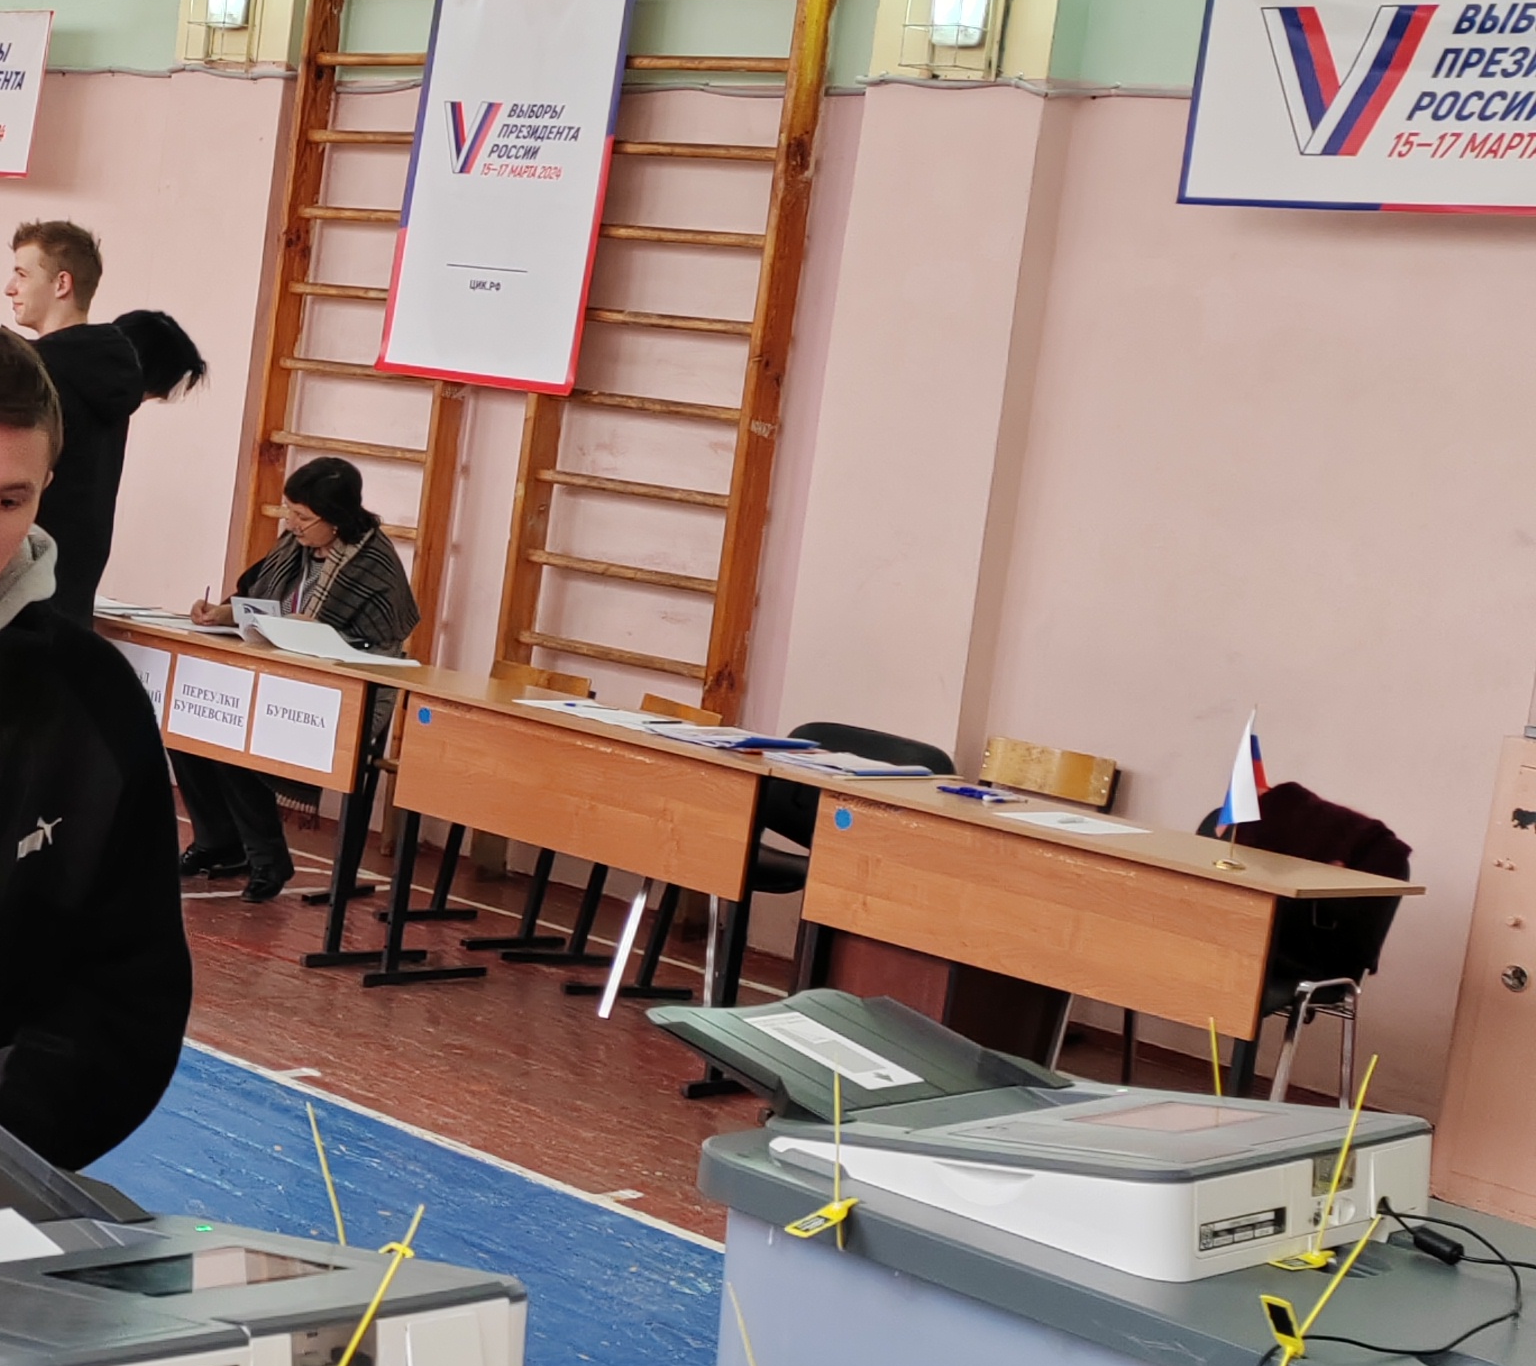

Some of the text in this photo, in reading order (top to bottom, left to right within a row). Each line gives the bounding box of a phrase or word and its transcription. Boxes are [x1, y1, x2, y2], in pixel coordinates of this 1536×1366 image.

[1452, 2, 1536, 35] ВЫБ
[507, 103, 566, 119] ВЫБОРЫ
[1406, 90, 1536, 122] РОССИ
[497, 124, 581, 142] ПРЕЗИДЕНТА
[487, 144, 541, 160] РОССИИ
[507, 165, 538, 178] МАРТА
[536, 166, 562, 180] 2024
[182, 683, 240, 710] ПЕРЕУЛКИ
[173, 699, 245, 729] БУРЦЕВСКИЕ
[265, 703, 326, 729] БУРЦЕВКА
